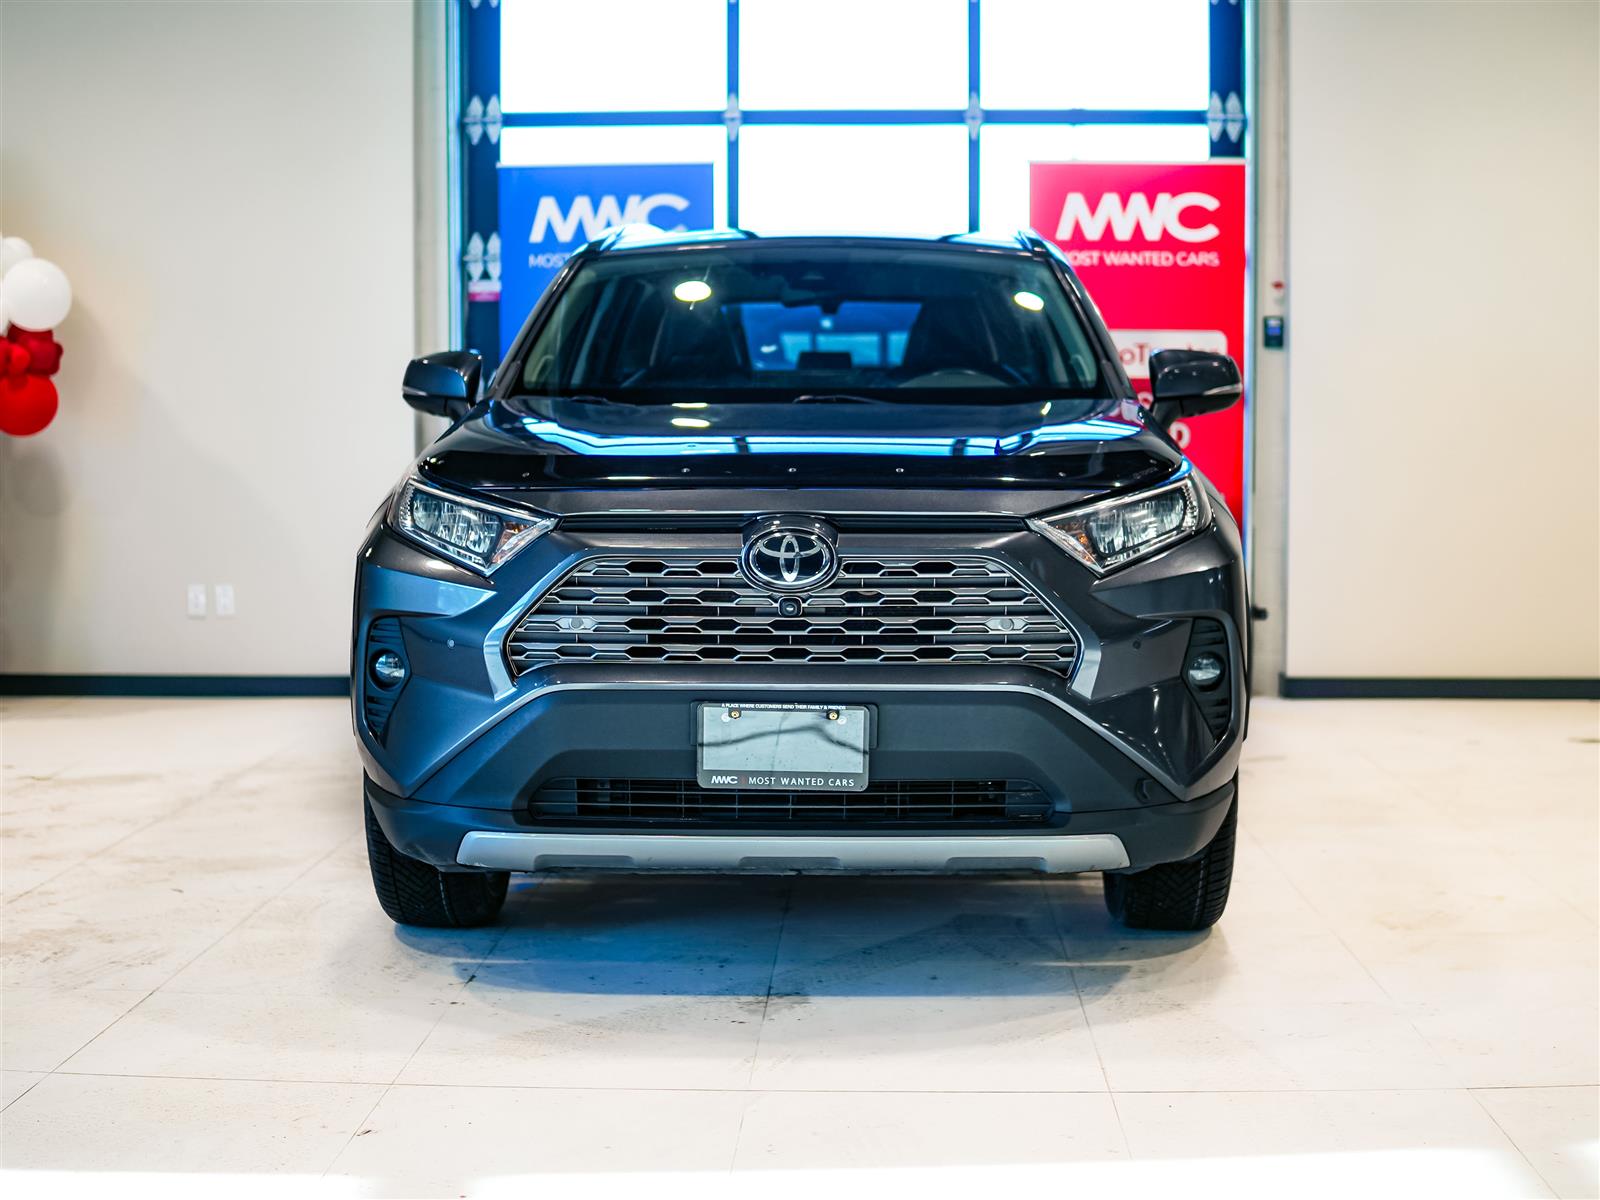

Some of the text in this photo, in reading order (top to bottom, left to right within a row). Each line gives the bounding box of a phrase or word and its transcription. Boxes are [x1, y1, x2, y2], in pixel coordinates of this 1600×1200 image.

[1055, 192, 1220, 243] MWC
[1067, 251, 1220, 267] OST WANTED CARS
[711, 775, 855, 787] MWC MOST WANTED CARS
